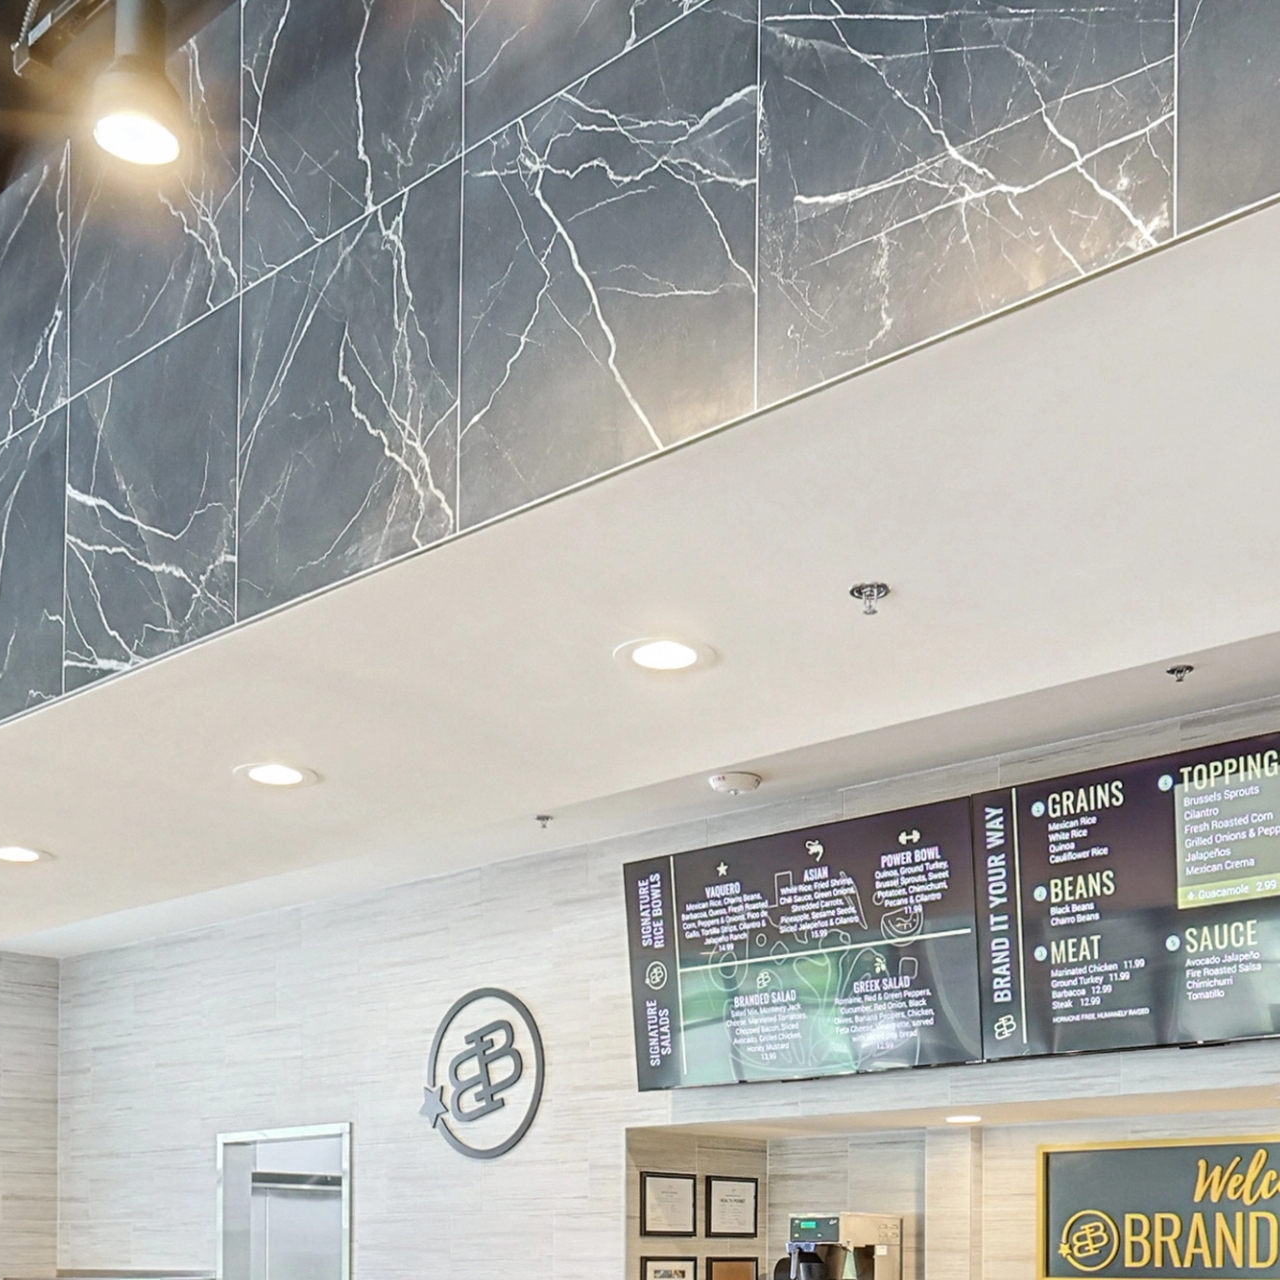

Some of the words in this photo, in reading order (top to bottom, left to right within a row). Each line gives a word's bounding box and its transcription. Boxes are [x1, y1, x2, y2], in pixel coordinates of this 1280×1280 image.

[1047, 780, 1124, 818] GRAINS
[1183, 791, 1222, 807] Brussels
[1224, 785, 1260, 801] Sprouts
[1184, 807, 1219, 820] Cilantro
[1184, 822, 1210, 834] Fresh
[1211, 814, 1249, 830] Roasted
[1250, 811, 1274, 823] Corn
[985, 806, 1005, 849] WAY
[1185, 835, 1213, 848] Grilled
[1215, 829, 1247, 843] Onions
[1248, 828, 1256, 838] &
[880, 850, 913, 868] POWER
[914, 846, 942, 863] BOWL
[1185, 847, 1232, 862] Jalapeños
[803, 866, 829, 882] ASIAN
[1185, 862, 1224, 876] Mexican
[1225, 857, 1255, 870] Crema
[704, 882, 741, 899] VAQUERO
[987, 853, 1008, 909] YOUR
[1050, 870, 1115, 903] BEANS
[1198, 884, 1250, 899] Guacamole
[1256, 879, 1277, 891] 2.99
[649, 872, 663, 920] BOWLS
[637, 878, 653, 948] SIGNATURE
[990, 914, 1009, 932] IT
[652, 924, 665, 949] RICE
[1185, 919, 1258, 953] SAUCE
[1051, 935, 1101, 965] MEAT
[1185, 955, 1221, 967] Avocado
[1222, 951, 1260, 962] Jalapeño
[990, 937, 1012, 1003] BRAND
[1050, 965, 1088, 978] Marinated
[1088, 962, 1118, 973] Chicken
[1123, 958, 1146, 969] 11.99
[1186, 969, 1202, 978] Fire
[1203, 964, 1237, 976] Roasted
[1238, 962, 1262, 973] Salsa
[853, 979, 881, 994] GREEK
[882, 975, 911, 990] SALAD
[1051, 976, 1079, 988] Ground
[1080, 974, 1105, 987] Turkey
[1109, 971, 1130, 981] 11.99
[734, 992, 769, 1007] BRANDED
[771, 989, 797, 1003] SALAD
[1186, 989, 1225, 1001] Tomatillo
[645, 999, 661, 1067] SIGNATURE
[658, 1007, 672, 1056] SALADS
